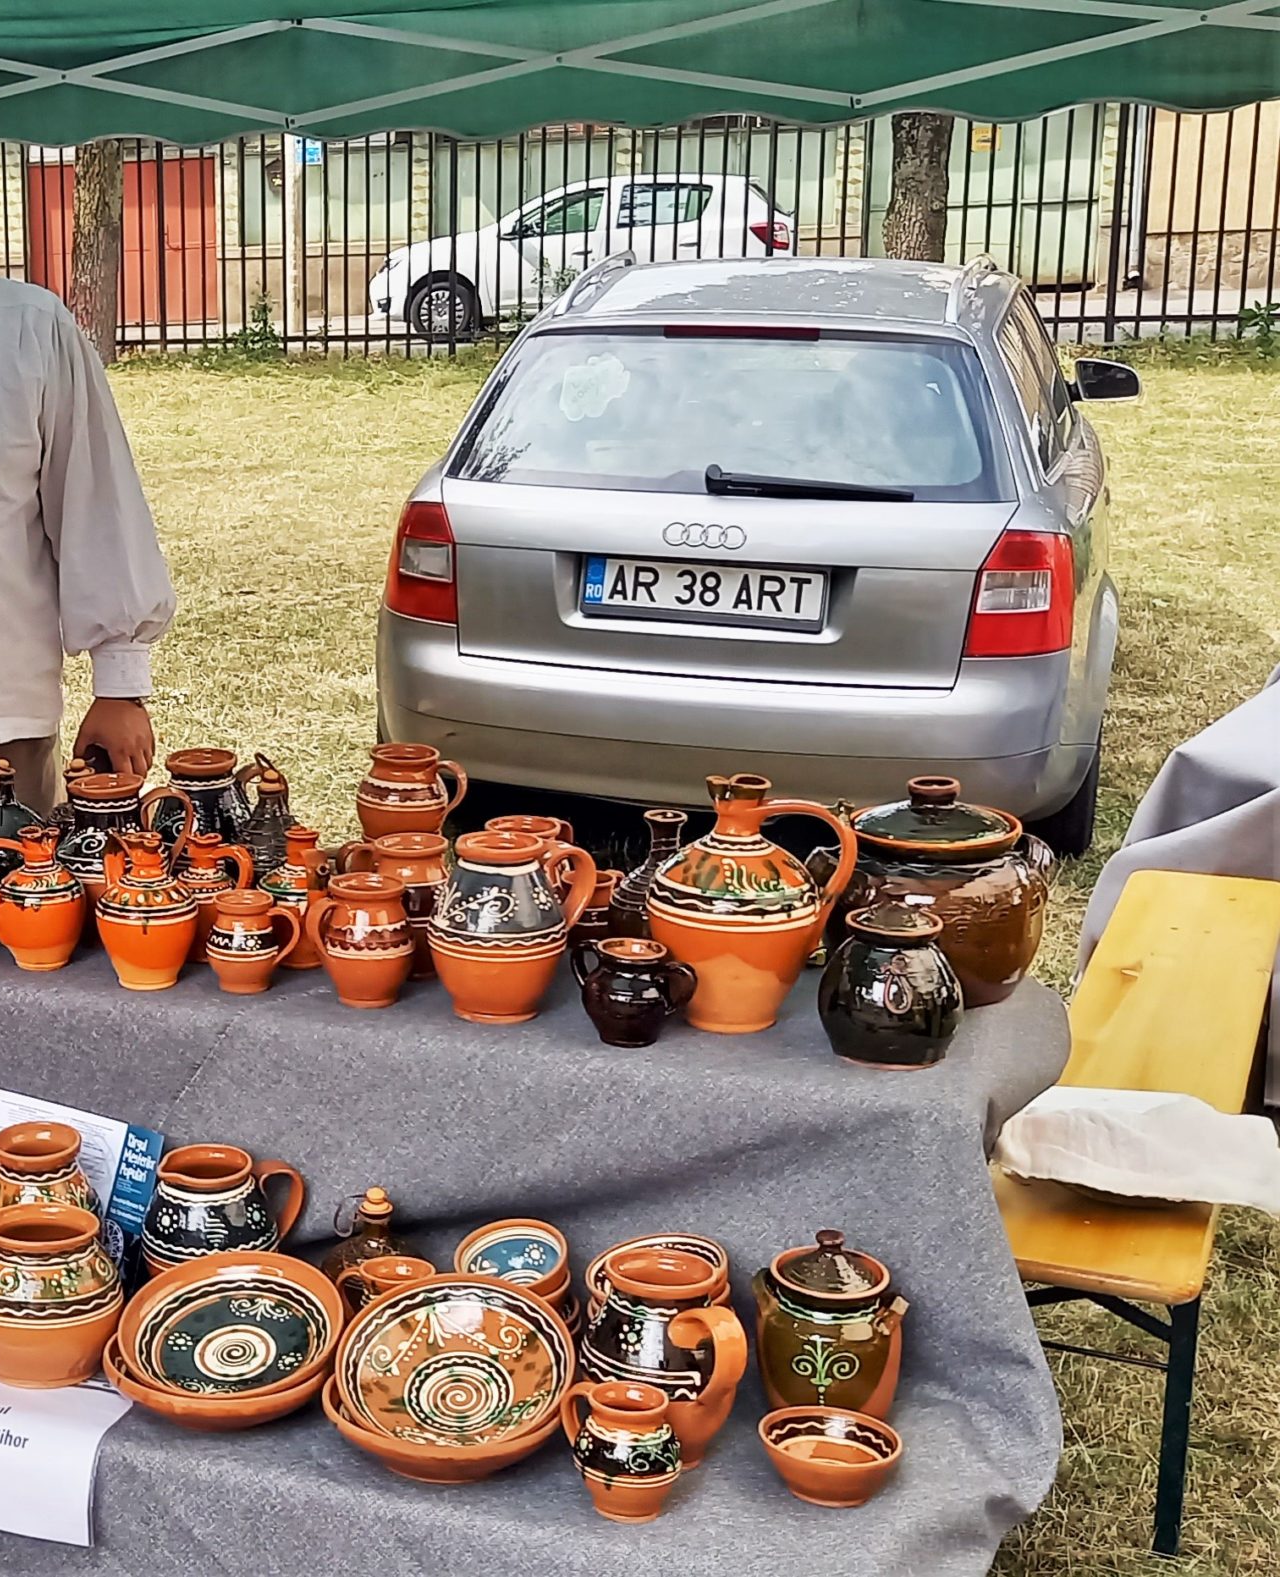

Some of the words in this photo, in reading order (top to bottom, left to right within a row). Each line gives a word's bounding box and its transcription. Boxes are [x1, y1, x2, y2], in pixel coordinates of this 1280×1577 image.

[585, 582, 602, 599] RO
[608, 564, 660, 603] AR
[674, 569, 722, 607] 38
[732, 573, 812, 614] ART
